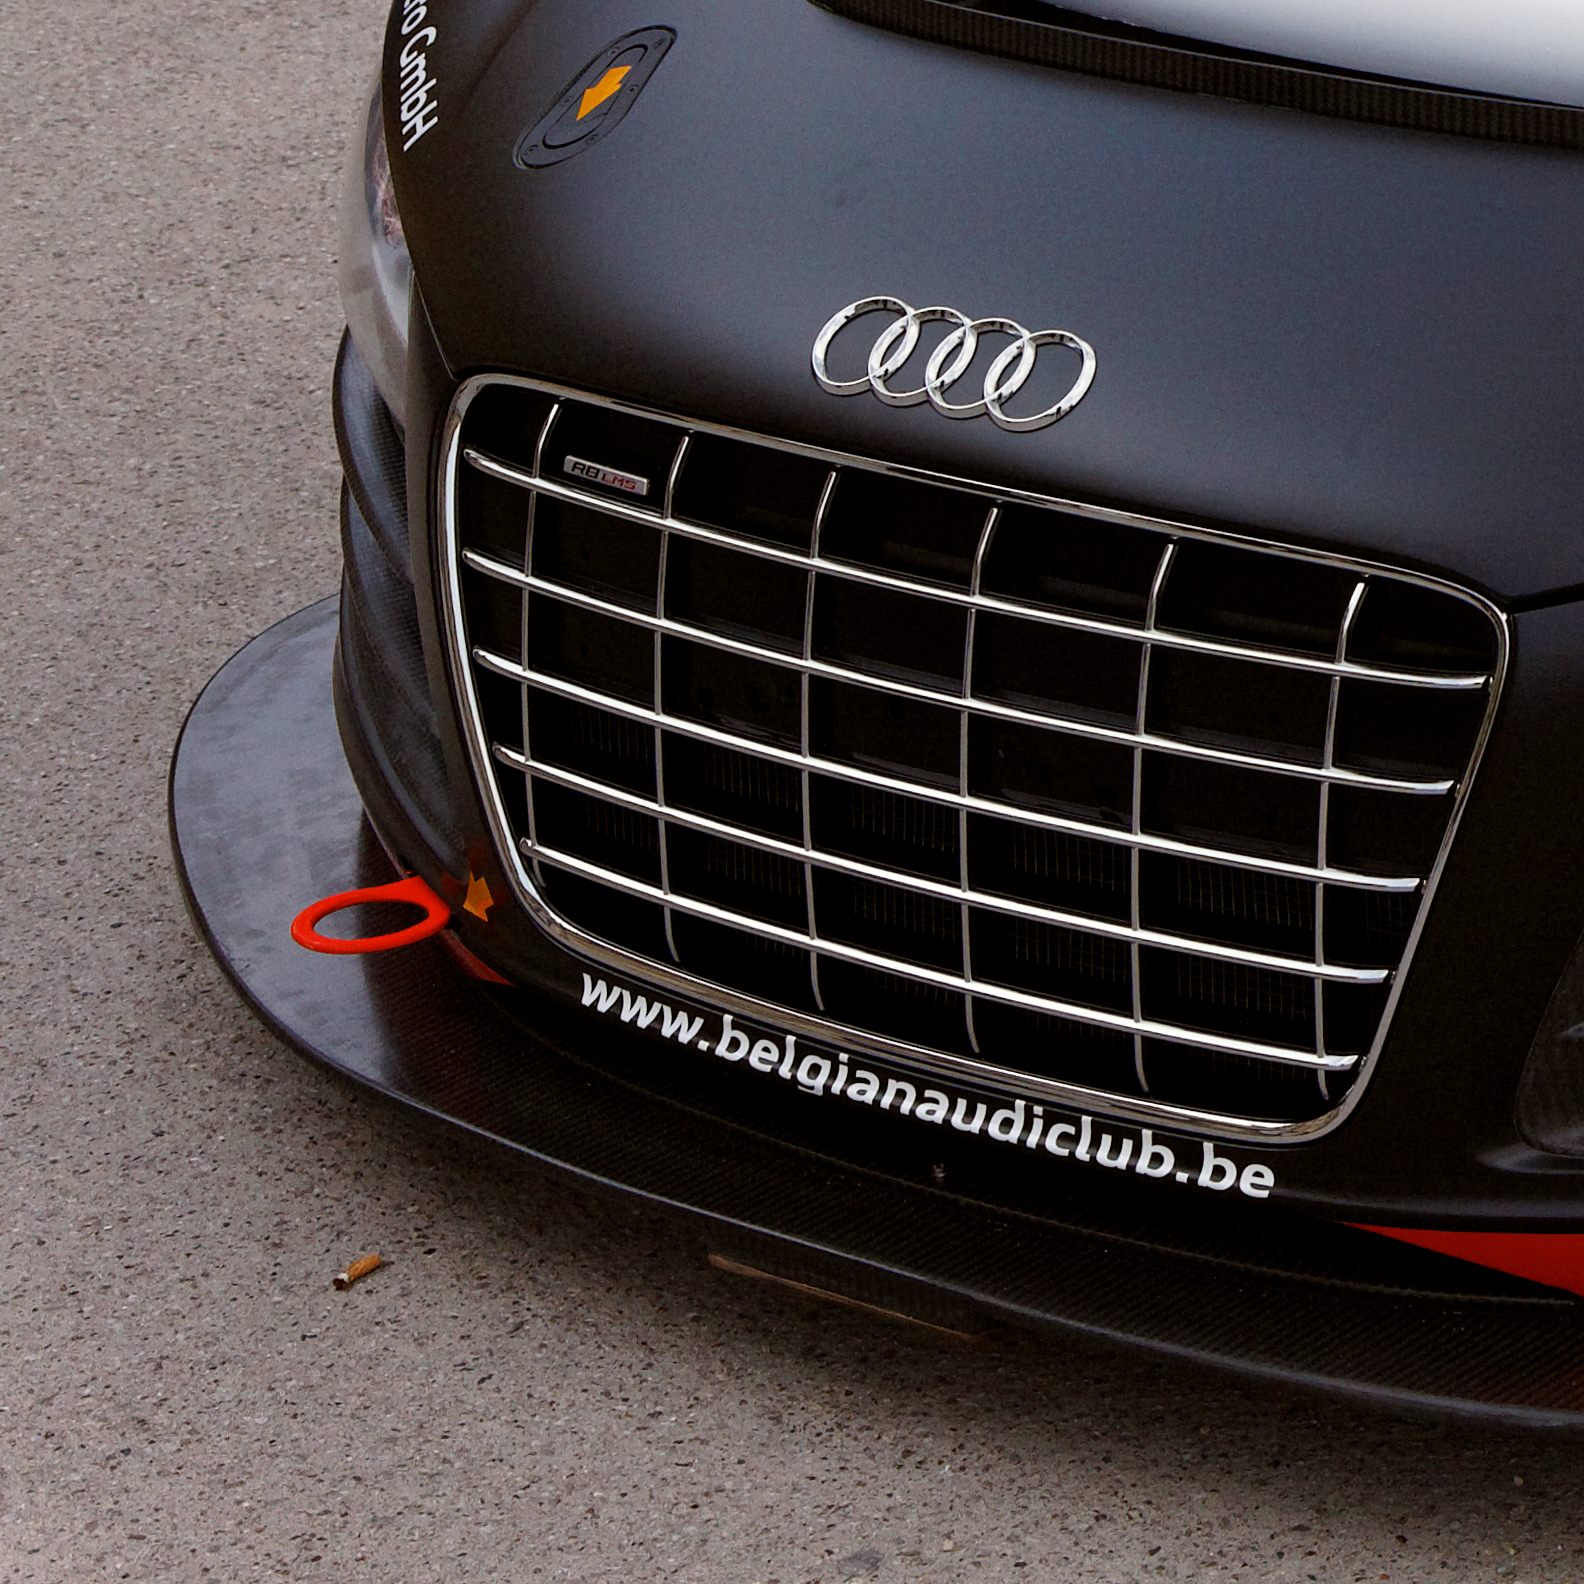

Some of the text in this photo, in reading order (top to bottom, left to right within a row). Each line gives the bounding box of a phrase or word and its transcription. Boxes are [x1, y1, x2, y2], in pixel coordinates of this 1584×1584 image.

[400, 26, 438, 151] GmbH
[571, 462, 637, 491] R8 LMS
[581, 973, 1275, 1199] www.belgianaudiclub.be
